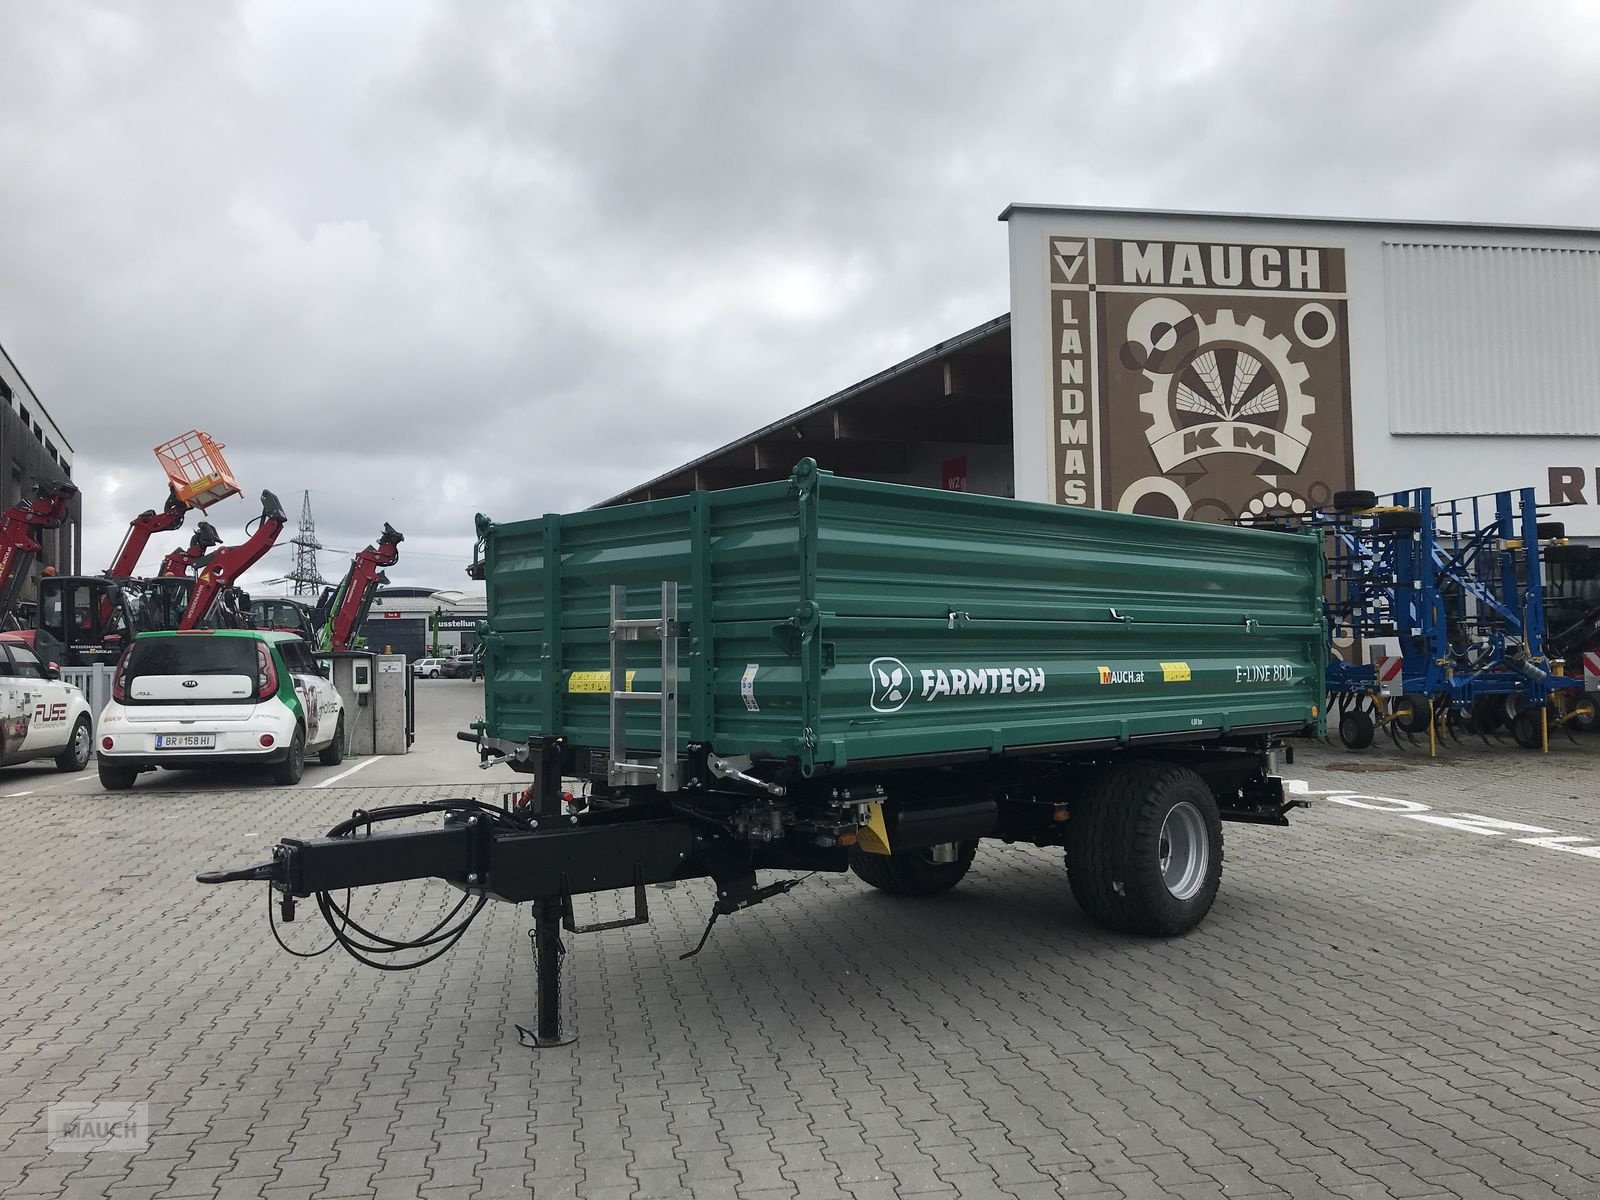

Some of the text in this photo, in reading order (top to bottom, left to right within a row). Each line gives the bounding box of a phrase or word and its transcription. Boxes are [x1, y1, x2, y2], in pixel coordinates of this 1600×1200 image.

[1122, 241, 1320, 289] MAUCH
[1060, 299, 1088, 505] LANDMAS
[1183, 426, 1276, 456] KM
[1547, 466, 1600, 505] R
[186, 584, 204, 619] WEIDEMANN
[432, 620, 476, 628] usstellun
[183, 680, 199, 689] KIA
[920, 668, 1046, 701] FARMTECH
[1102, 671, 1145, 685] MAUCH.at
[1235, 665, 1272, 683] E-LINE
[33, 703, 68, 723] FUSE
[165, 735, 210, 746] BR 158 HI
